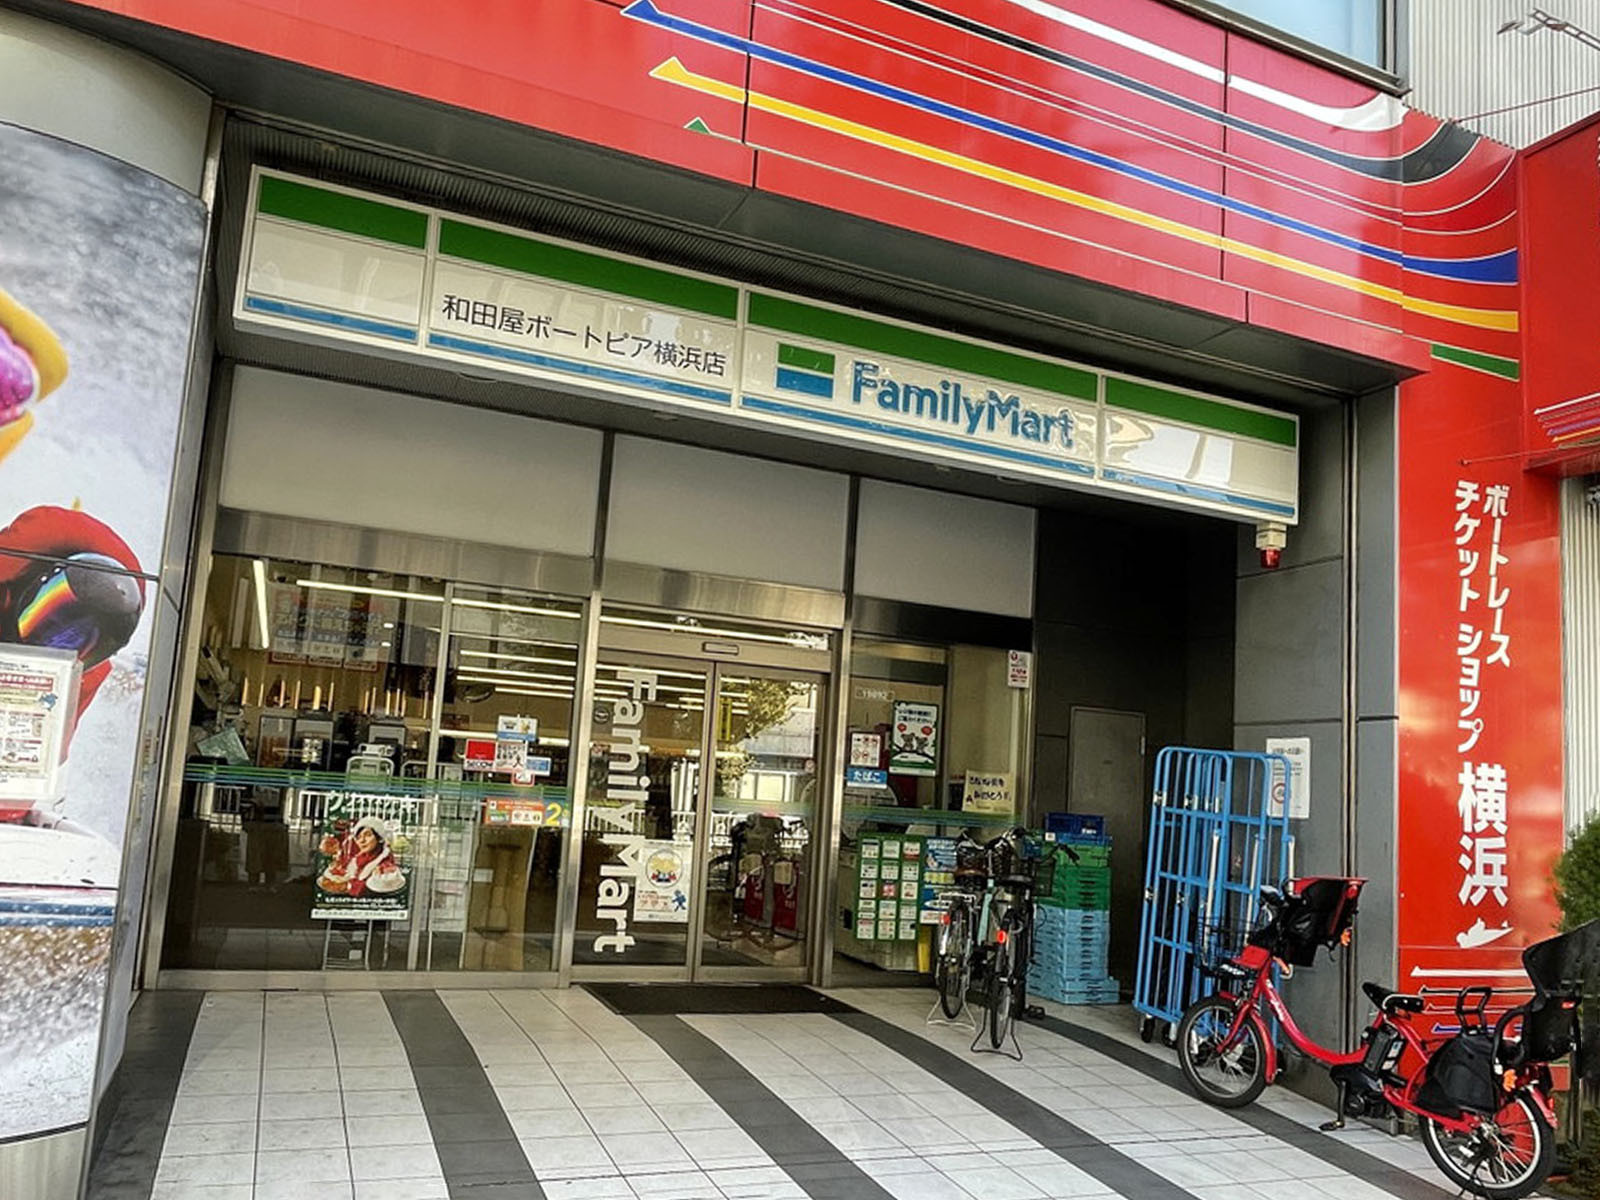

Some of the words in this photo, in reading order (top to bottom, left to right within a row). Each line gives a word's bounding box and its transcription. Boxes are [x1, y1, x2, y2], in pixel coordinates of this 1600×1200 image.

[441, 294, 727, 377] 和田屋ボートピア横浜店
[850, 360, 1076, 449] FamilyMart
[1483, 484, 1511, 668] ボートレース
[592, 670, 658, 954] FamilyMart
[853, 770, 881, 783] たばこ
[1457, 761, 1509, 907] 横浜
